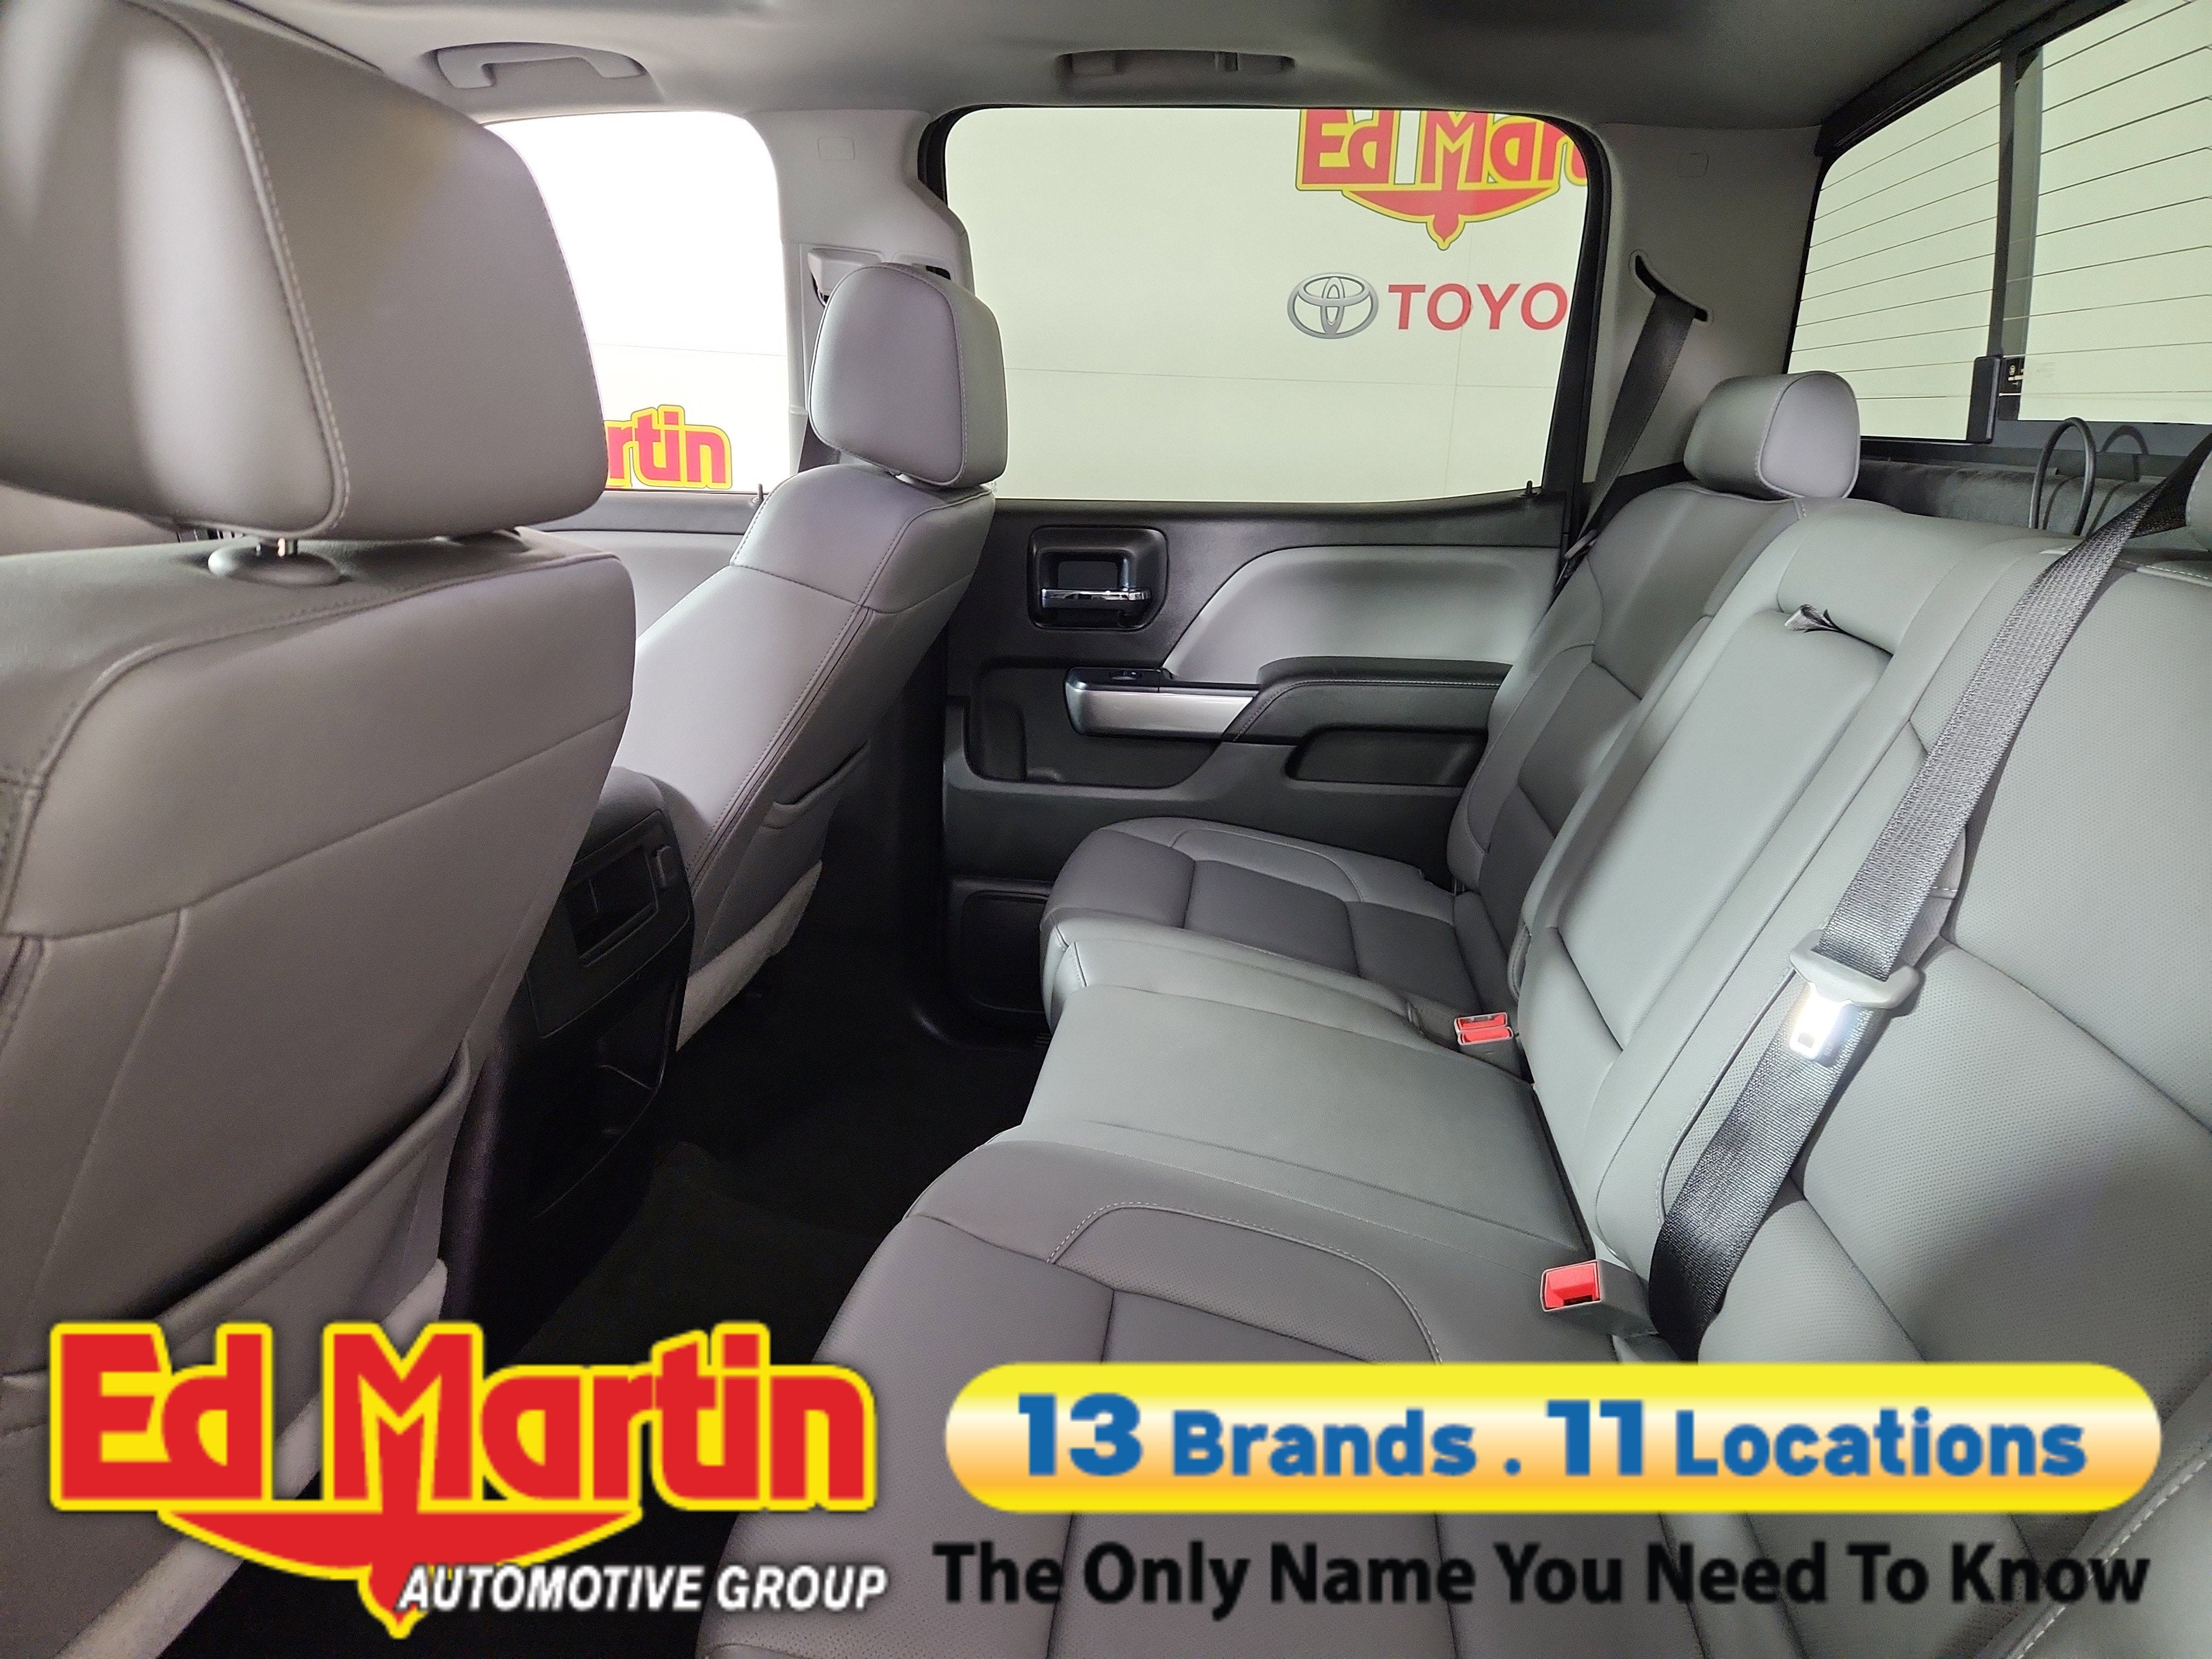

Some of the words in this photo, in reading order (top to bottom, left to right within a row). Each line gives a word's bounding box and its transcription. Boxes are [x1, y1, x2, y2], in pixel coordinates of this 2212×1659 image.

[1301, 110, 1398, 185] Ed
[1418, 110, 1587, 184] Mar
[1388, 282, 1567, 330] TOYO
[607, 409, 726, 484] rtin
